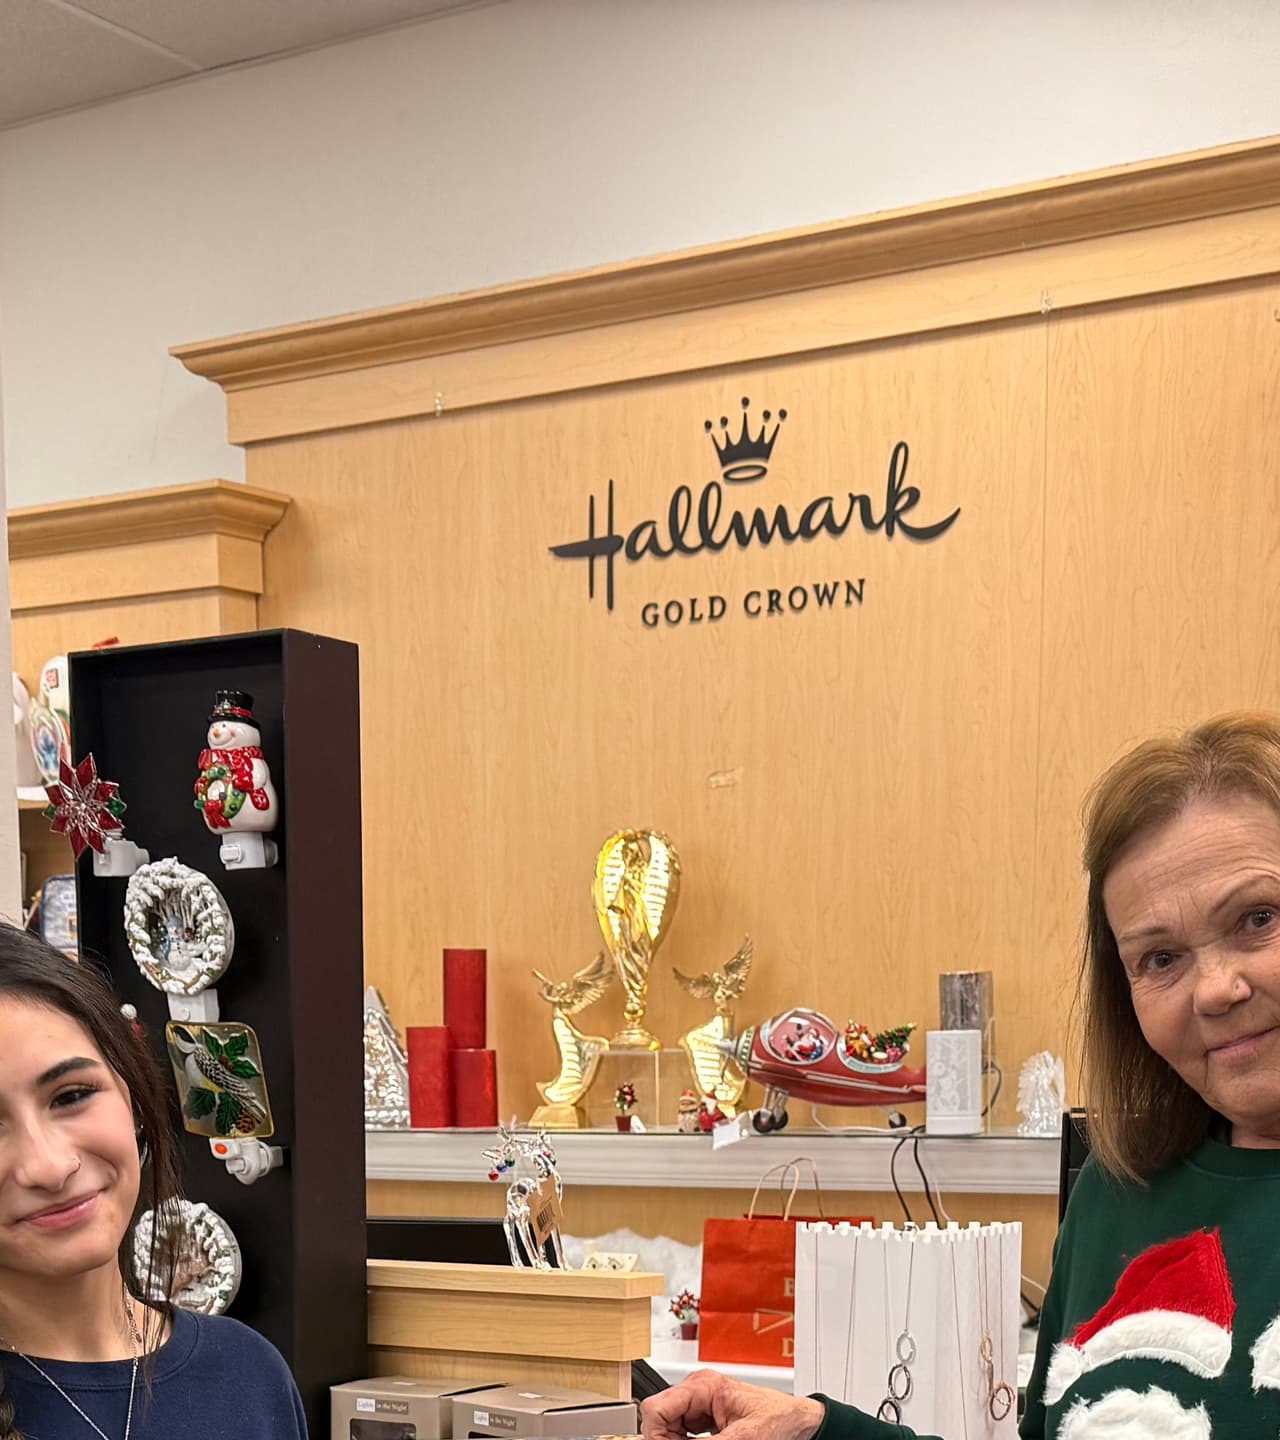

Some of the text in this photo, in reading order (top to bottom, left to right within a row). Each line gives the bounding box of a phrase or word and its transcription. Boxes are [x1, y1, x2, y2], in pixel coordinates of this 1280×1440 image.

[548, 441, 961, 611] Hallmark
[642, 579, 867, 628] GOLD CROWN
